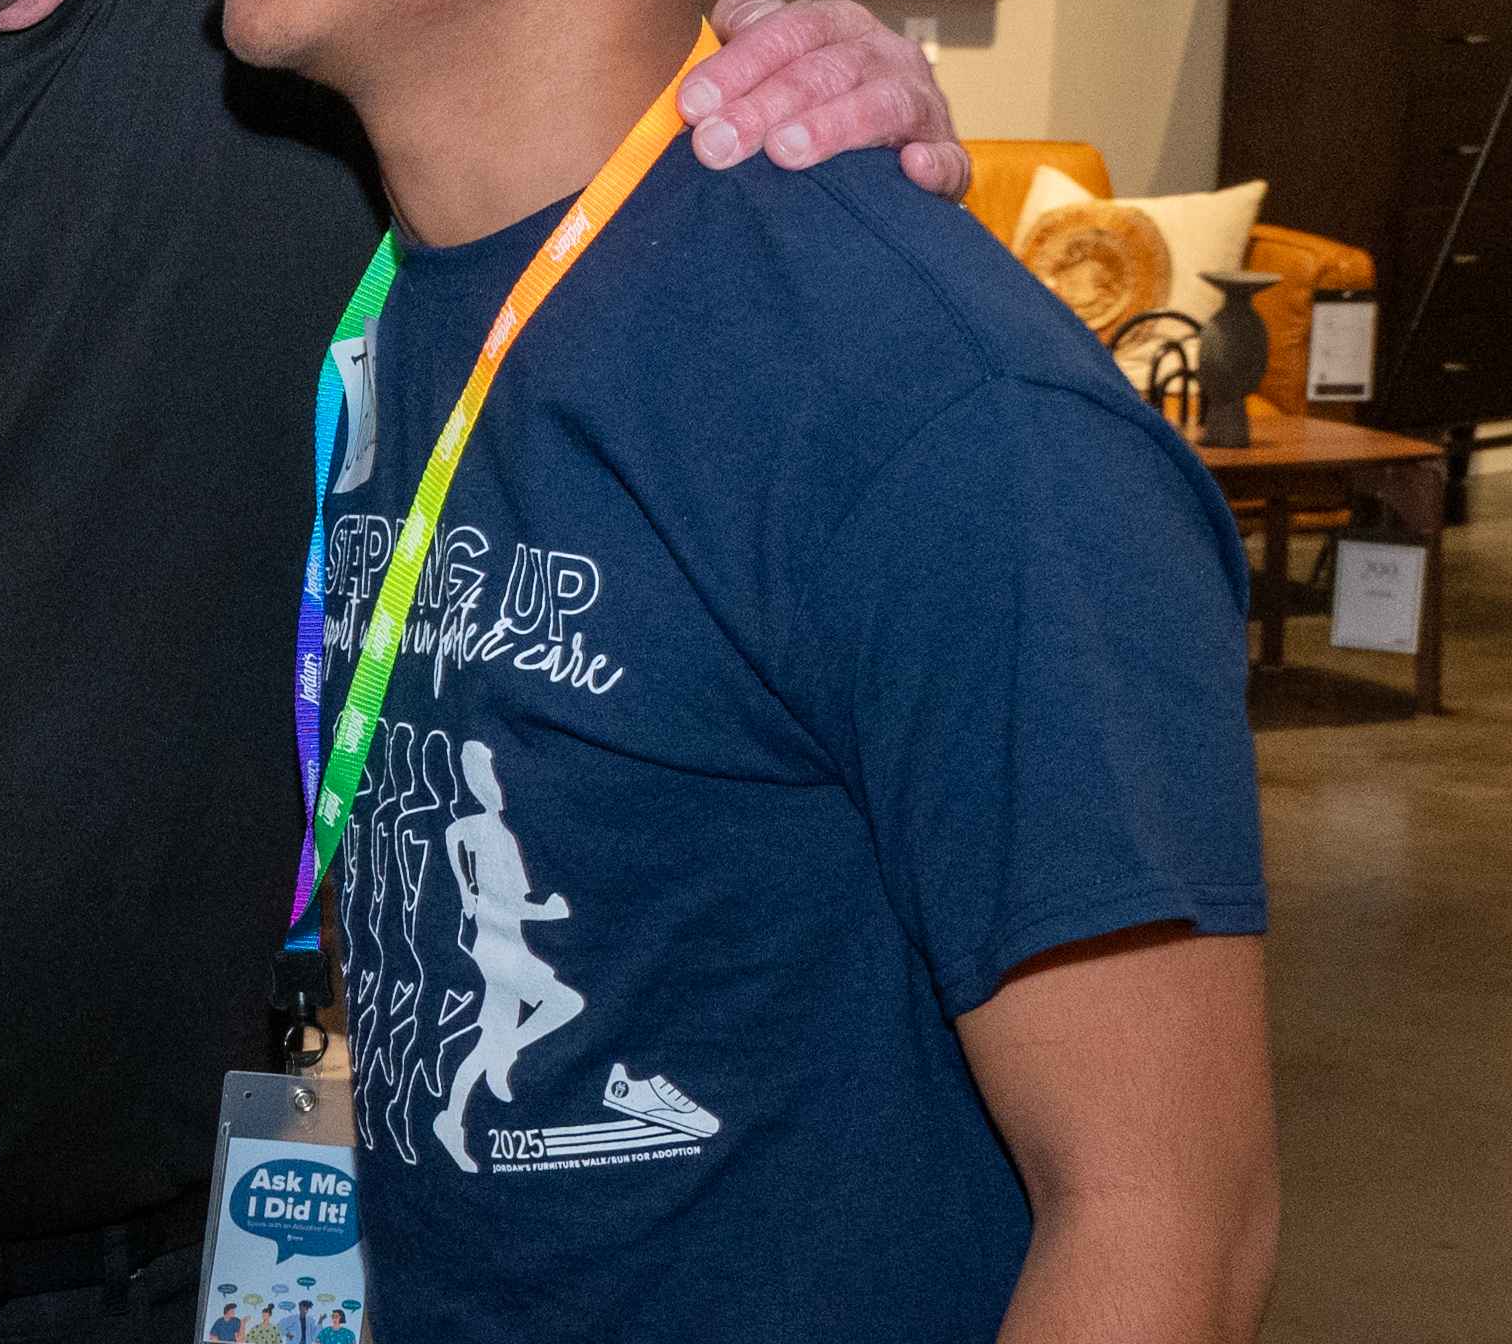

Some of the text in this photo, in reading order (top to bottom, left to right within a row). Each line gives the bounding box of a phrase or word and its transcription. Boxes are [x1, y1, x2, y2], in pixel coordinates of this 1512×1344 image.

[325, 514, 490, 612] STEPNG
[501, 543, 601, 642] UP
[299, 652, 320, 706] Jordan's
[512, 631, 624, 695] care
[487, 1128, 545, 1160] 2025
[492, 1146, 702, 1174] JORDAN'S FURNITURE WALK/RUN FOR ADOPTION
[249, 1167, 353, 1197] Ask Me
[247, 1196, 348, 1225] I Did It!
